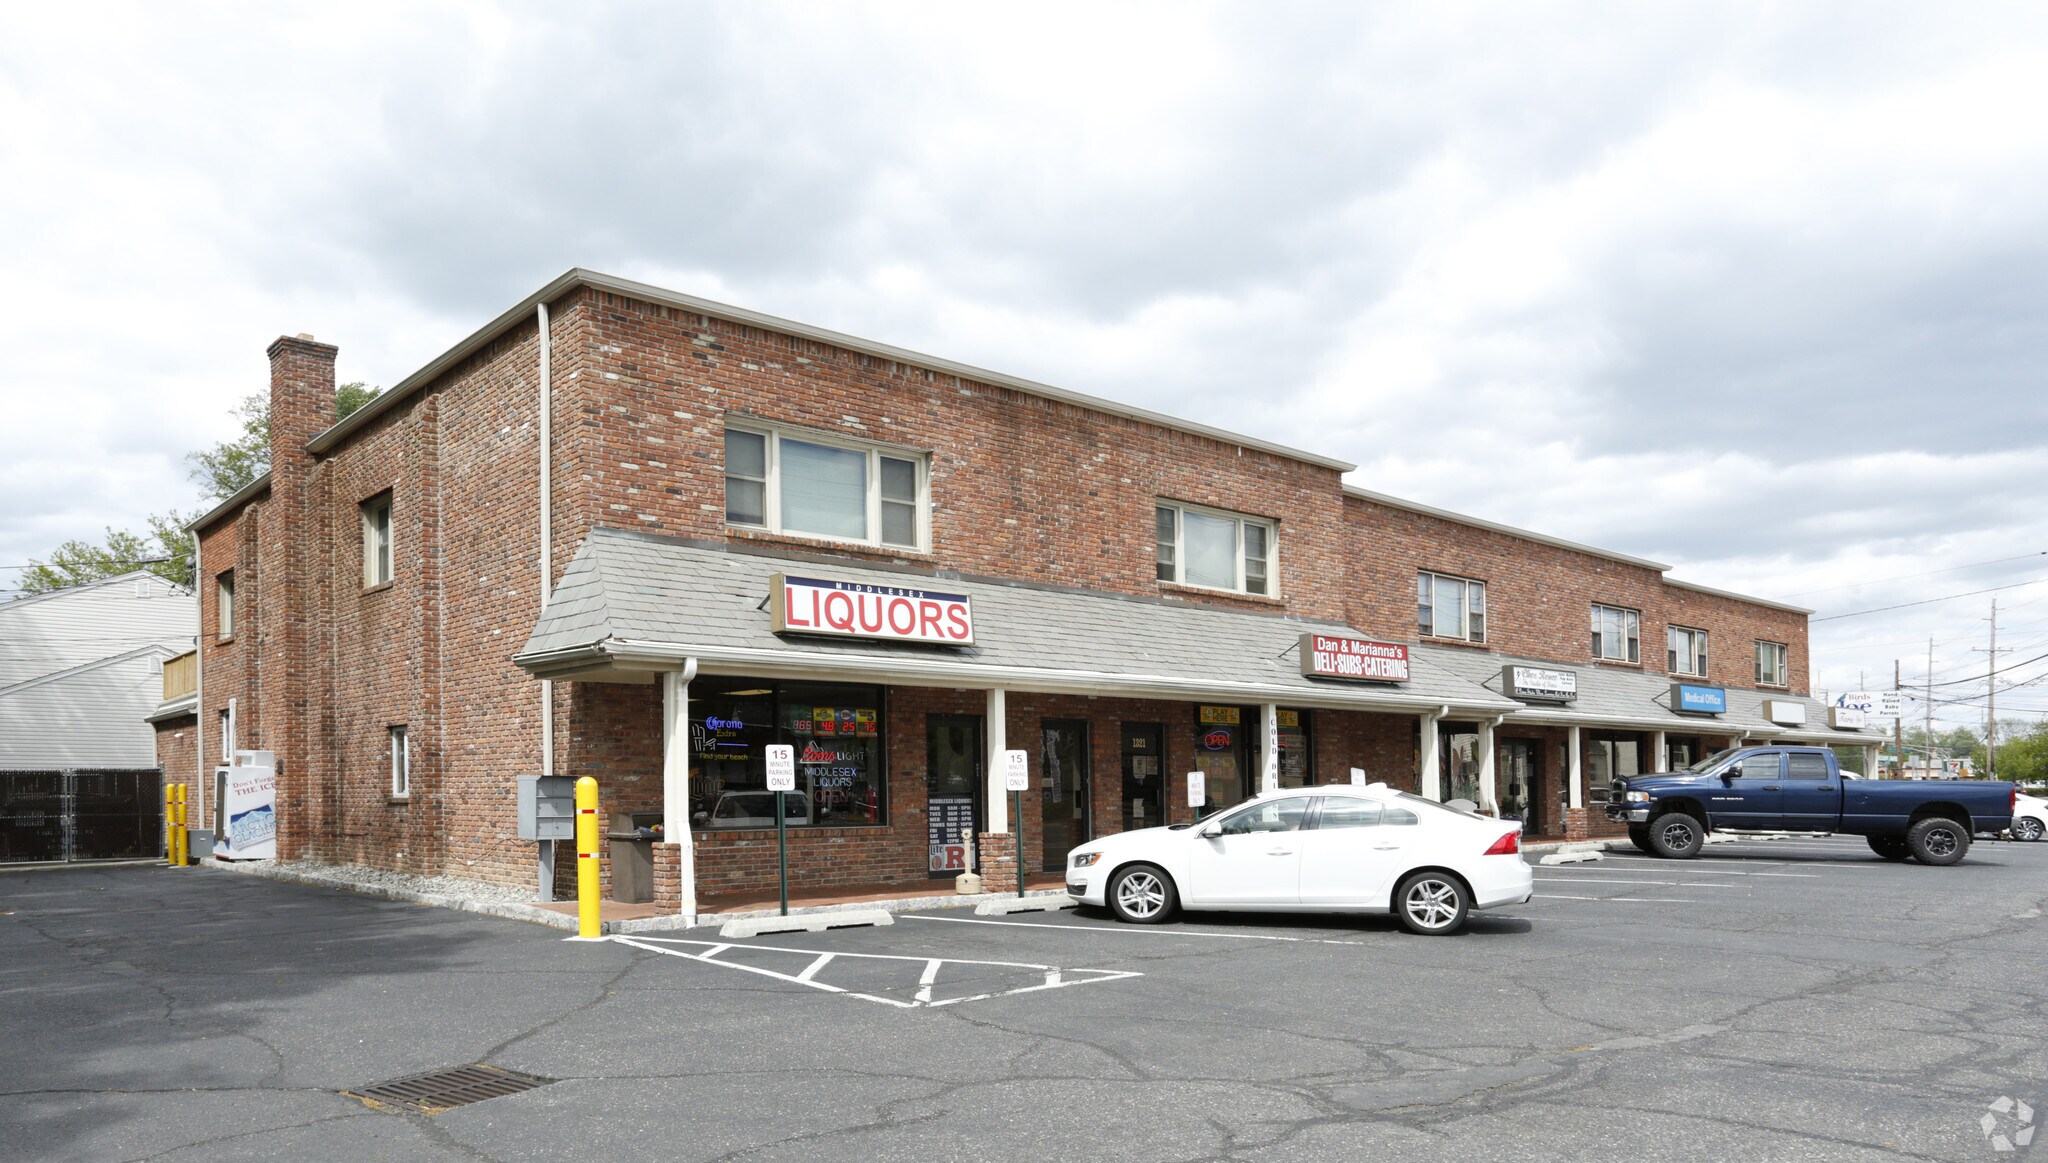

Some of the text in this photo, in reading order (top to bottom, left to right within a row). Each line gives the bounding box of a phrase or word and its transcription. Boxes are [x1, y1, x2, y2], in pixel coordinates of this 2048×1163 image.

[835, 582, 925, 598] MIDDLESEX
[785, 587, 969, 640] LIQUORS
[1317, 637, 1403, 658] Dan & Marianna's
[1684, 691, 1721, 705] Medical Office
[1212, 708, 1228, 716] PLAY
[1212, 714, 1228, 722] HERE
[705, 716, 743, 730] Corona
[716, 729, 737, 737] Extra
[1204, 734, 1230, 747] OPEN
[772, 750, 788, 760] 15
[802, 746, 865, 761] Coors LIGHT
[1010, 754, 1023, 763] 15
[804, 767, 857, 778] MIDDLESEX
[232, 776, 275, 789] Don't Forge
[771, 777, 790, 786] ONLY
[813, 777, 853, 787] LIQUORS
[1009, 778, 1025, 786] ONLY
[234, 787, 258, 797] THE
[814, 789, 849, 803] OPEN
[231, 813, 275, 836] ARCTIC
[930, 845, 966, 869] Lite R
